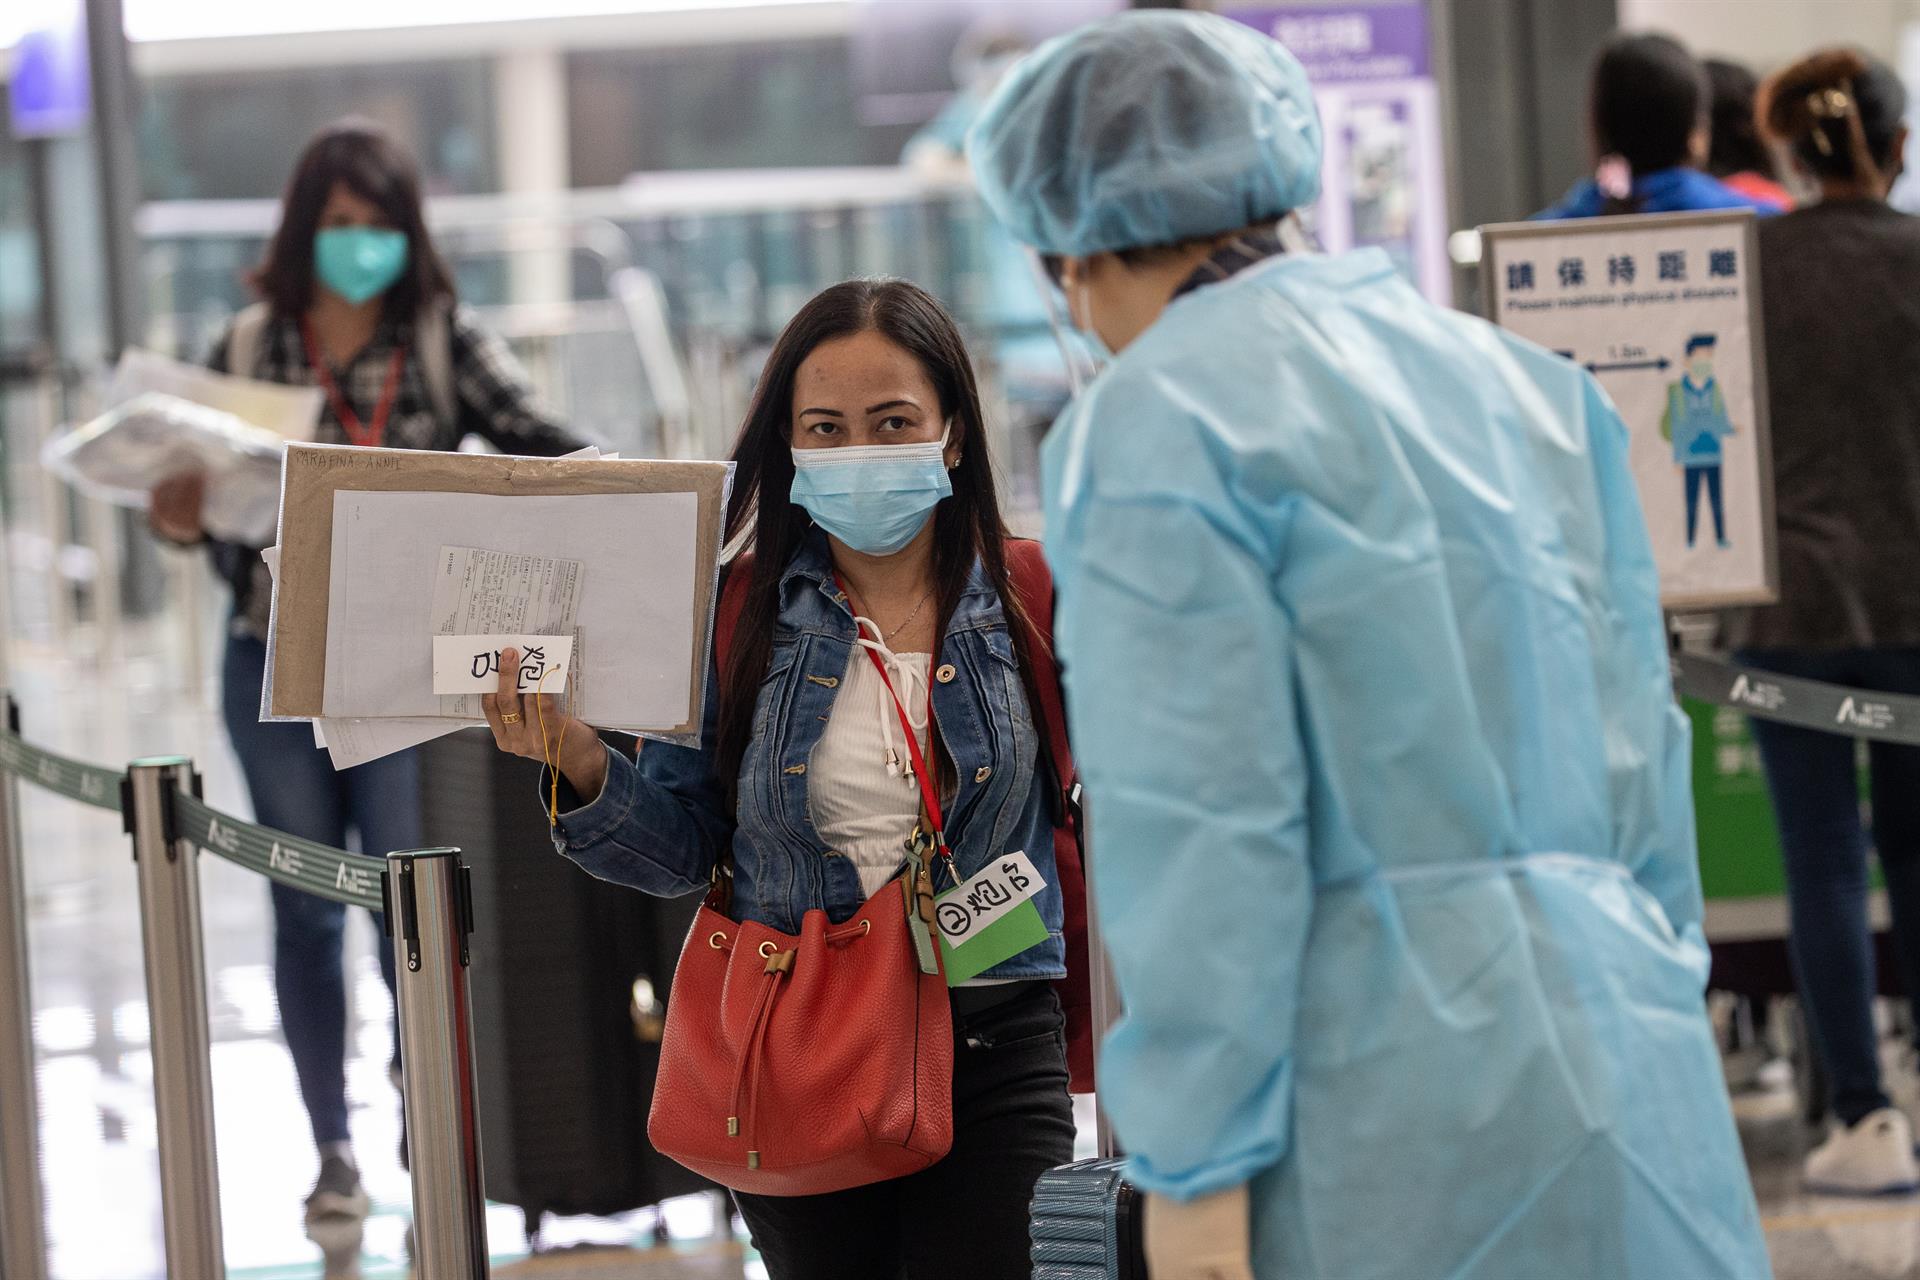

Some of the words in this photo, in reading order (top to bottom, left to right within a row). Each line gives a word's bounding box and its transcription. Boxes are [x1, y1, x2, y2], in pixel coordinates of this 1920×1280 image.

[1507, 248, 1738, 291] 請保持距離
